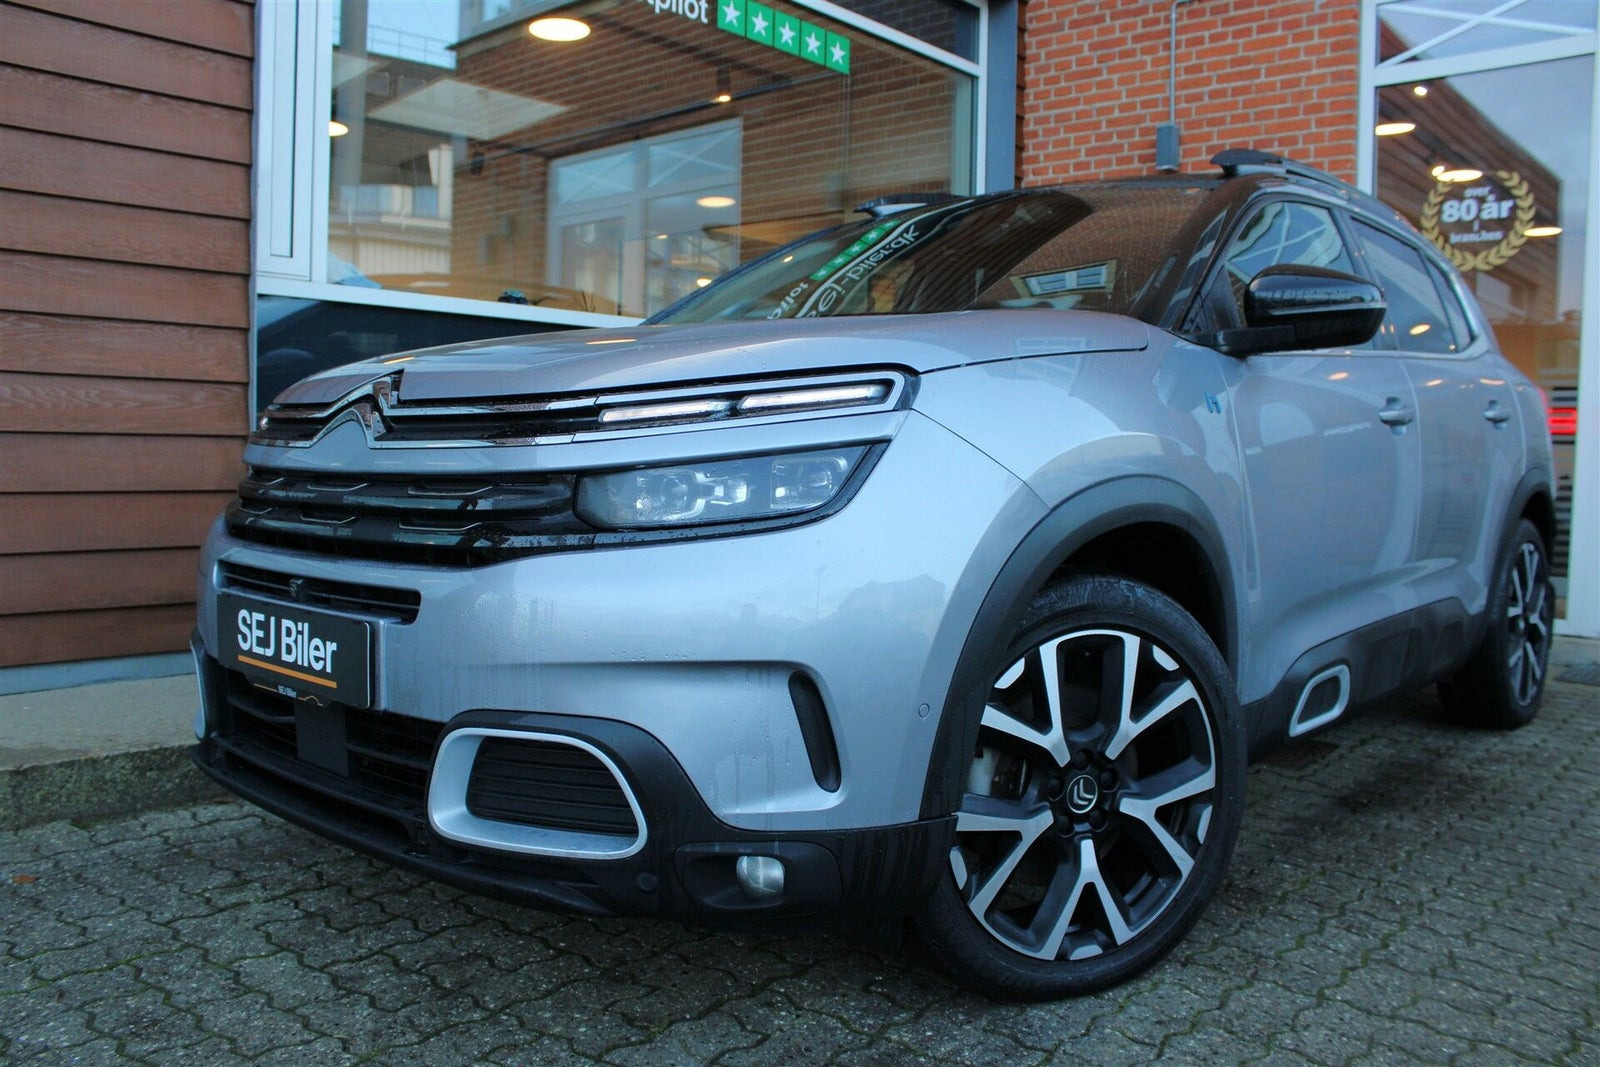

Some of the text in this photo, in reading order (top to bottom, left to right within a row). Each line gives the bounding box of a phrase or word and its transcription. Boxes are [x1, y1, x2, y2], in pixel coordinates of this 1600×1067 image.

[648, 0, 709, 24] pilot
[1441, 194, 1515, 223] 80 år
[1449, 230, 1504, 244] branchen
[237, 608, 338, 674] SEJ Biler
